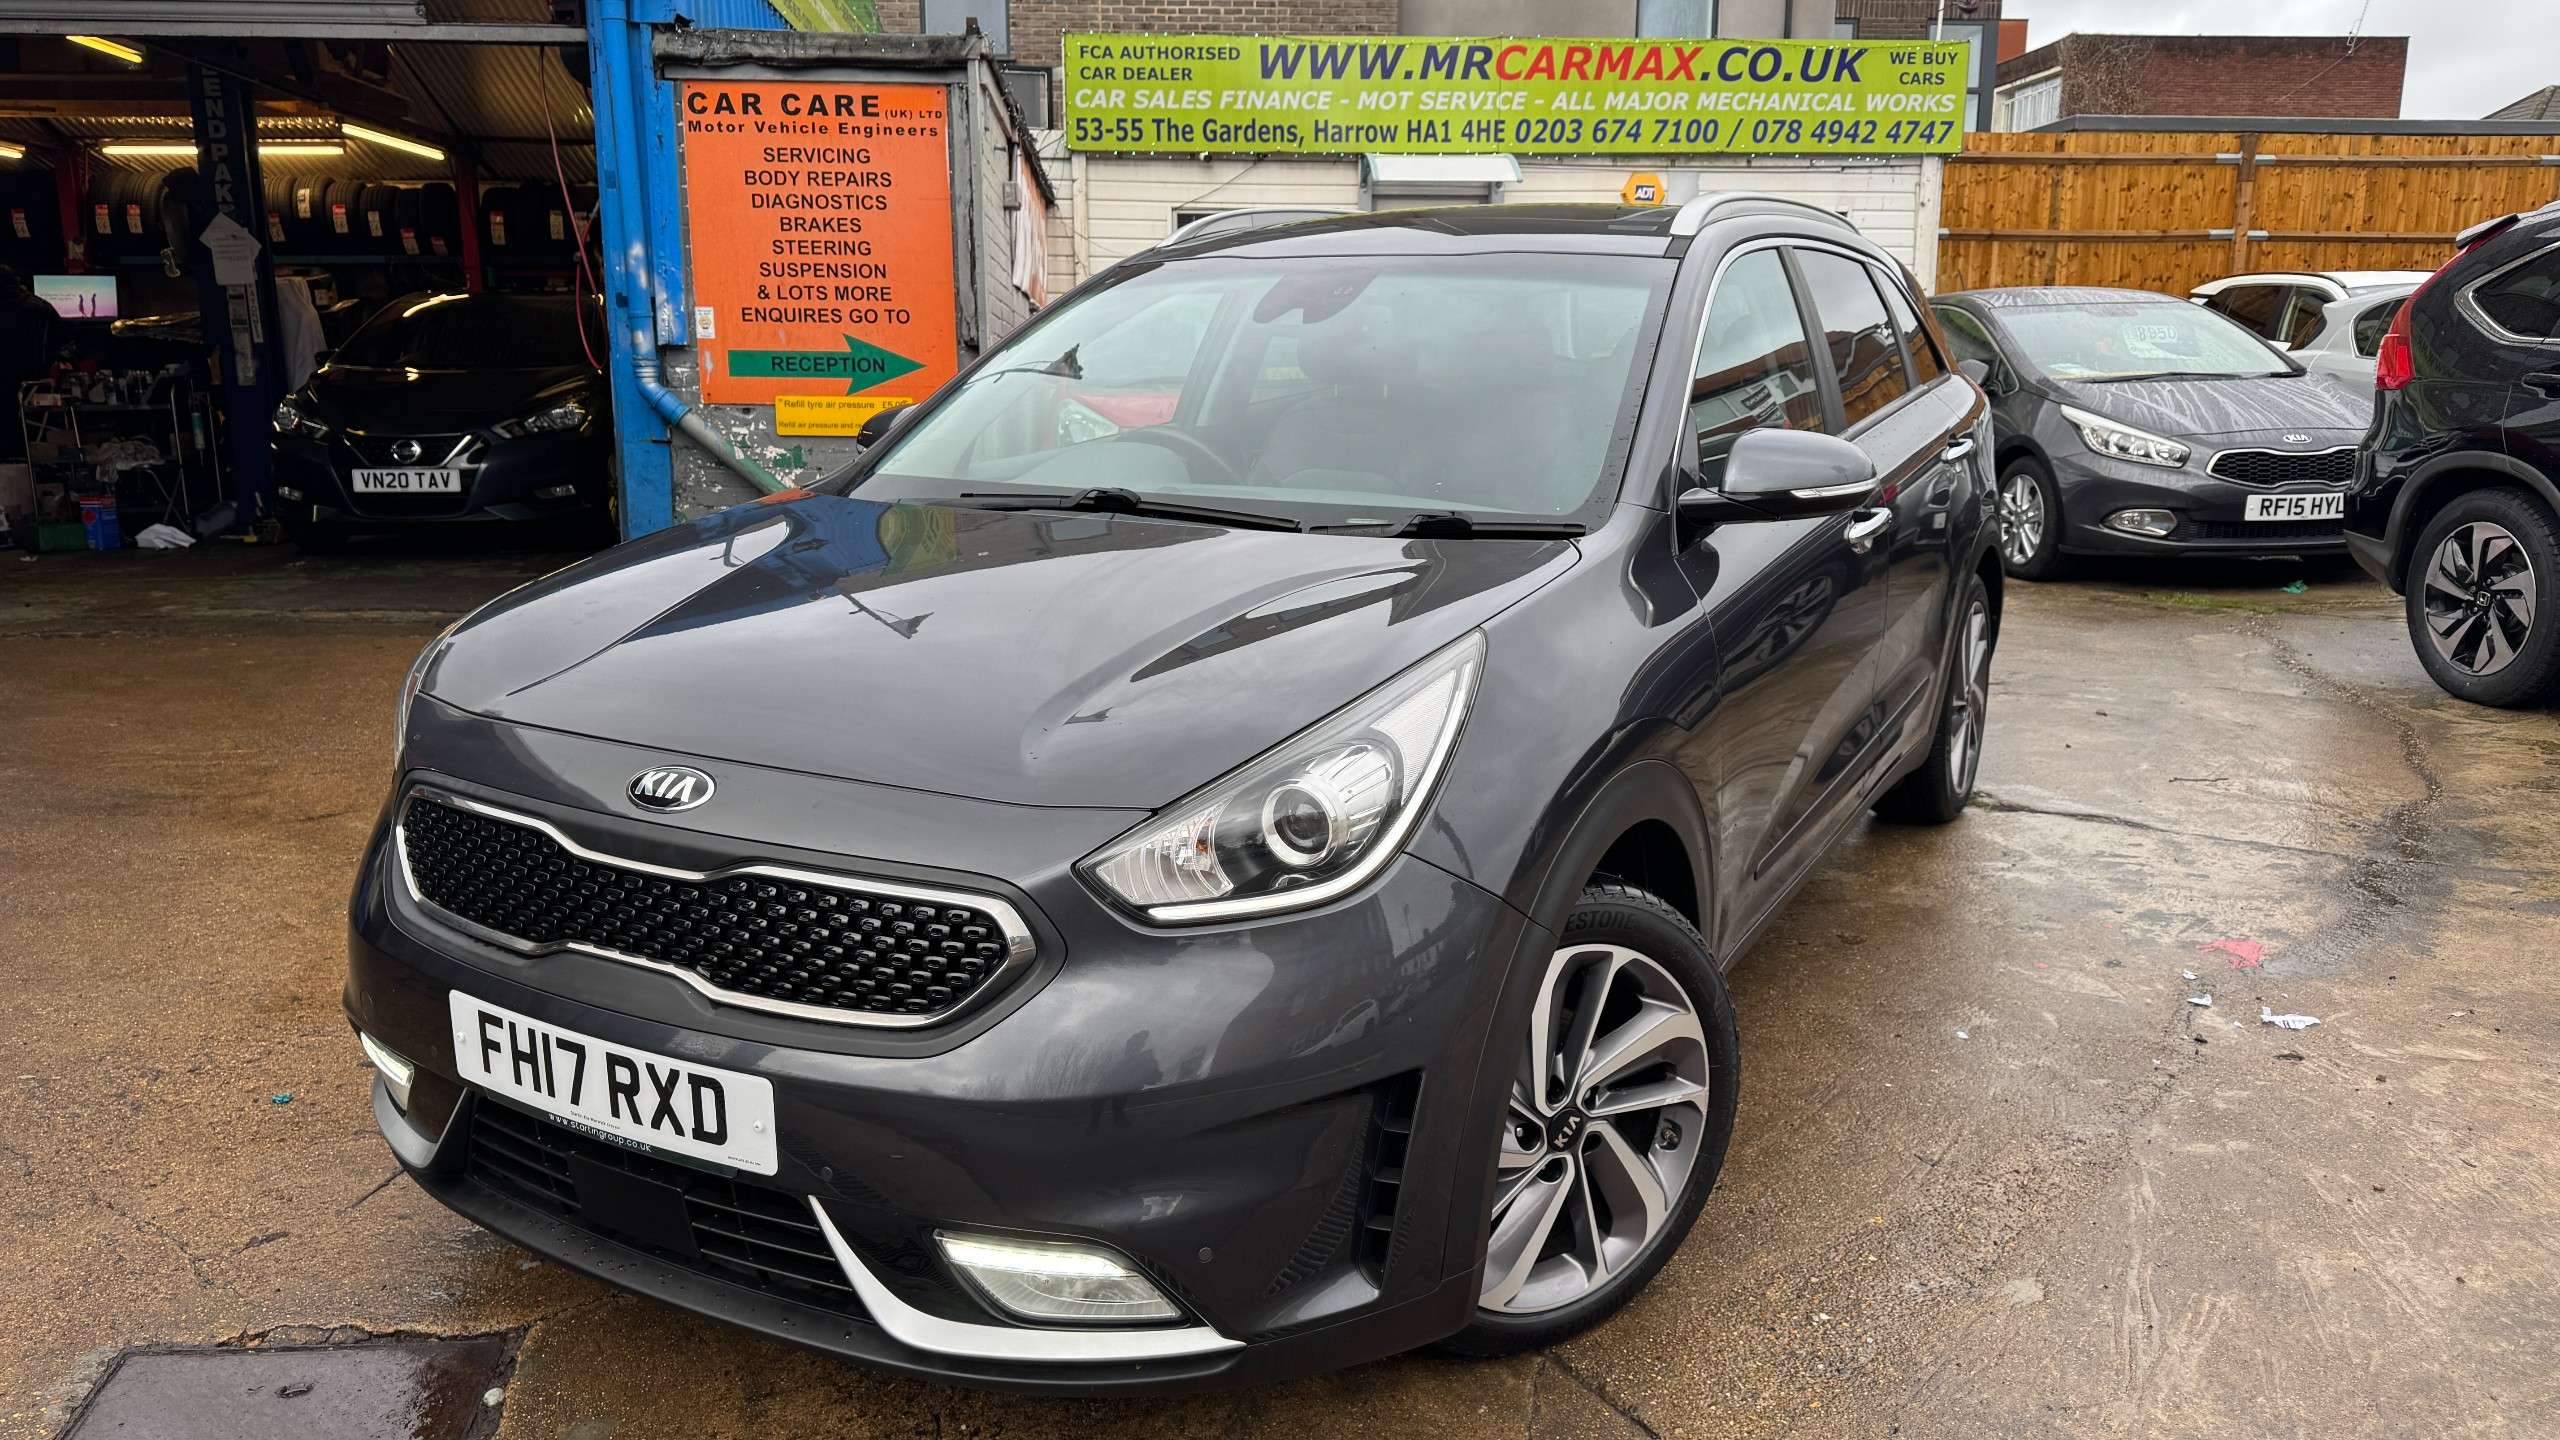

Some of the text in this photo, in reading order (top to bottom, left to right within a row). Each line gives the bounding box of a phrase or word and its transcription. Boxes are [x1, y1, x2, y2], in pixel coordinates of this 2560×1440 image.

[1079, 46, 1241, 61] FCA AUTHORISED
[1890, 52, 1958, 65] WE BUY
[1260, 44, 1868, 83] WWW.MRCARMAX.CO.UK
[1080, 66, 1193, 81] CAR DEALER
[1899, 72, 1945, 85] CARS
[687, 92, 943, 120] CAR CARE (UK) LTD
[1074, 89, 1126, 109] CAR
[1133, 89, 1213, 110] SALES
[1219, 90, 1332, 110] FINANCE
[1357, 91, 1414, 110] MOT
[1419, 91, 1527, 111] SERVICE
[1551, 92, 1596, 111] ALL
[1604, 91, 1690, 111] MAJOR
[1696, 91, 1857, 112] MECHANICAL
[1866, 94, 1956, 113] WORKS
[688, 120, 939, 138] Motor Vehicle Engineers
[1076, 118, 1144, 143] 53-55
[1152, 118, 1195, 143] The
[1202, 118, 1305, 148] Gardens,
[1314, 119, 1399, 143] Harrow
[1407, 119, 1452, 143] HA1
[1461, 119, 1506, 143] 4HE
[1515, 118, 1583, 144] 0203
[1592, 118, 1643, 144] 674
[1652, 118, 1719, 144] 7100
[1752, 119, 1803, 144] 078
[1810, 119, 1878, 144] 4942
[1886, 119, 1955, 145] 4747
[763, 147, 871, 164] SERVICING
[744, 170, 892, 187] BODY REPAIRS
[751, 193, 888, 210] DIAGNOSTICS
[1634, 186, 1656, 200] ADT
[780, 217, 862, 233] BRAKES
[772, 240, 872, 256] STEERING
[759, 262, 887, 279] SUSPENSION
[757, 285, 892, 302] & LOTS MORE
[741, 307, 911, 324] ENQUIRES GO TO
[771, 356, 886, 373] RECEPTION
[784, 399, 806, 408] Refill
[807, 400, 823, 410] tyre
[825, 400, 836, 408] air
[838, 401, 875, 411] pressure
[361, 472, 450, 488] VN20 TAV
[2260, 497, 2306, 516] RF15
[632, 769, 700, 804] KIA
[477, 1009, 728, 1146] FH17 RXD
